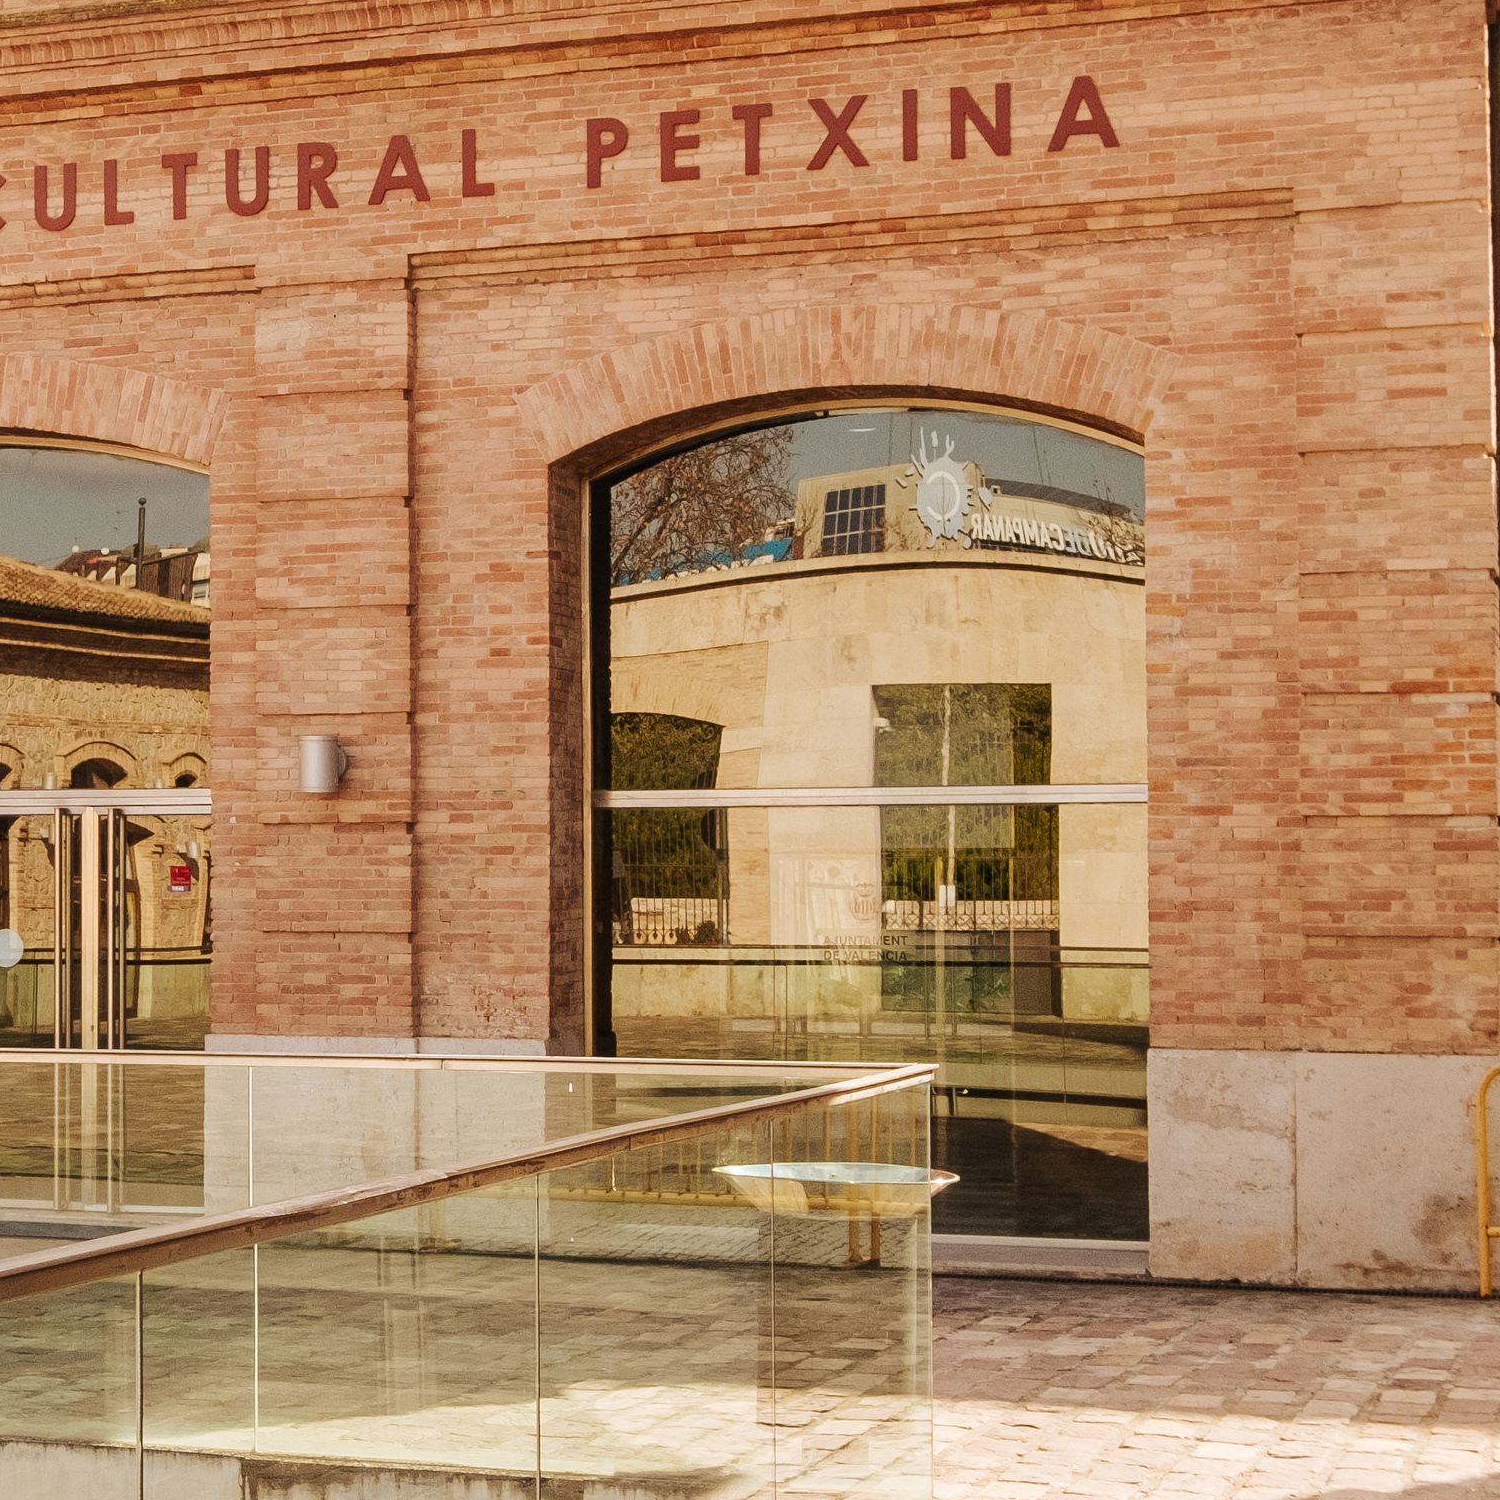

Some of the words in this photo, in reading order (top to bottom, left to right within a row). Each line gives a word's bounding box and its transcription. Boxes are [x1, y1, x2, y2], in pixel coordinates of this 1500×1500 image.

[586, 75, 1120, 190] PETXINA
[823, 935, 908, 946] AJUNTAMENT
[823, 950, 840, 961] DE
[844, 950, 908, 961] VALENCIA
